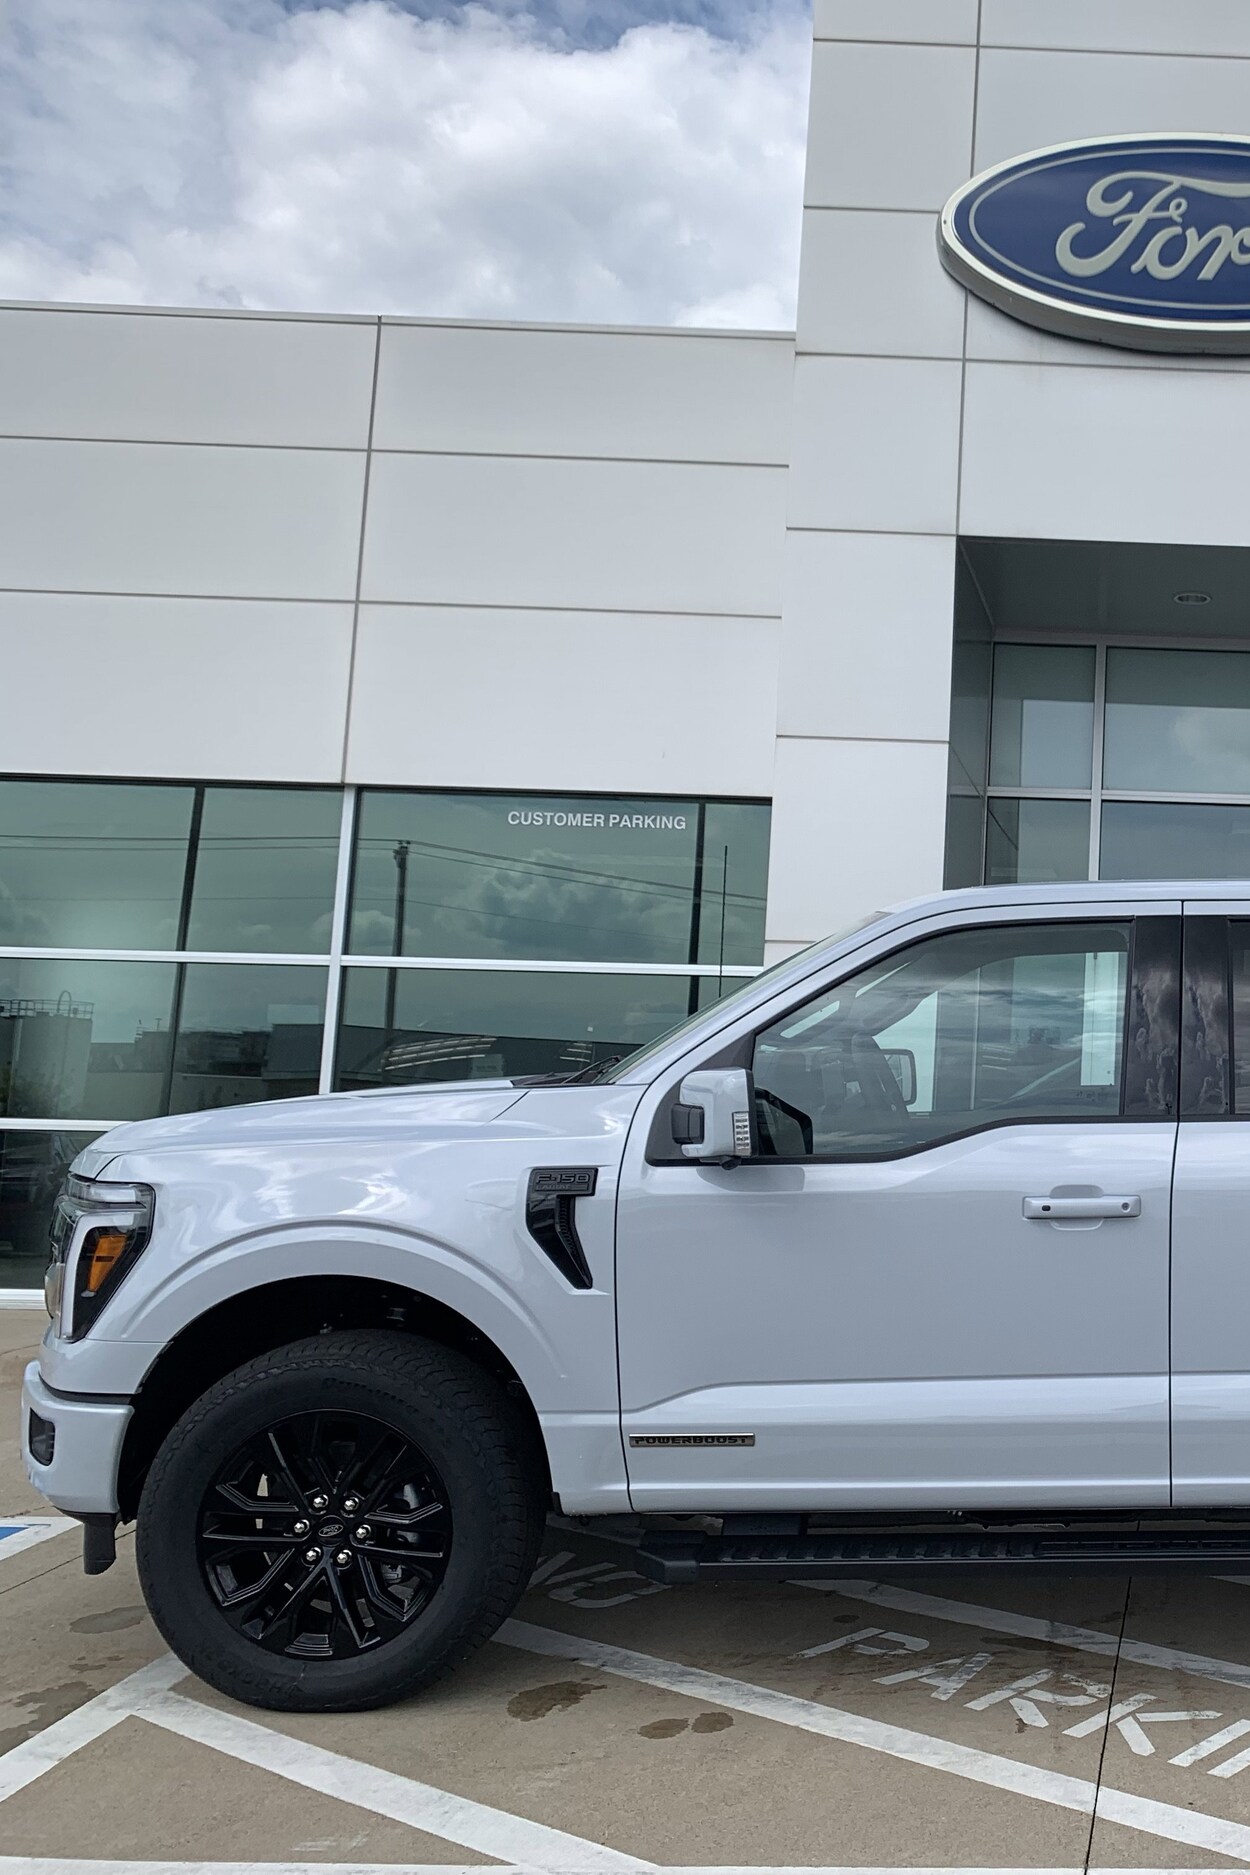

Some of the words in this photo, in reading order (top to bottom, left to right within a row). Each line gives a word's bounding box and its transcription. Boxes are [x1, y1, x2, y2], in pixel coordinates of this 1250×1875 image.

[508, 811, 604, 827] CUSTOMER
[609, 814, 686, 830] PARKING
[537, 1173, 590, 1183] F-150
[634, 1435, 749, 1445] POWERBOOST
